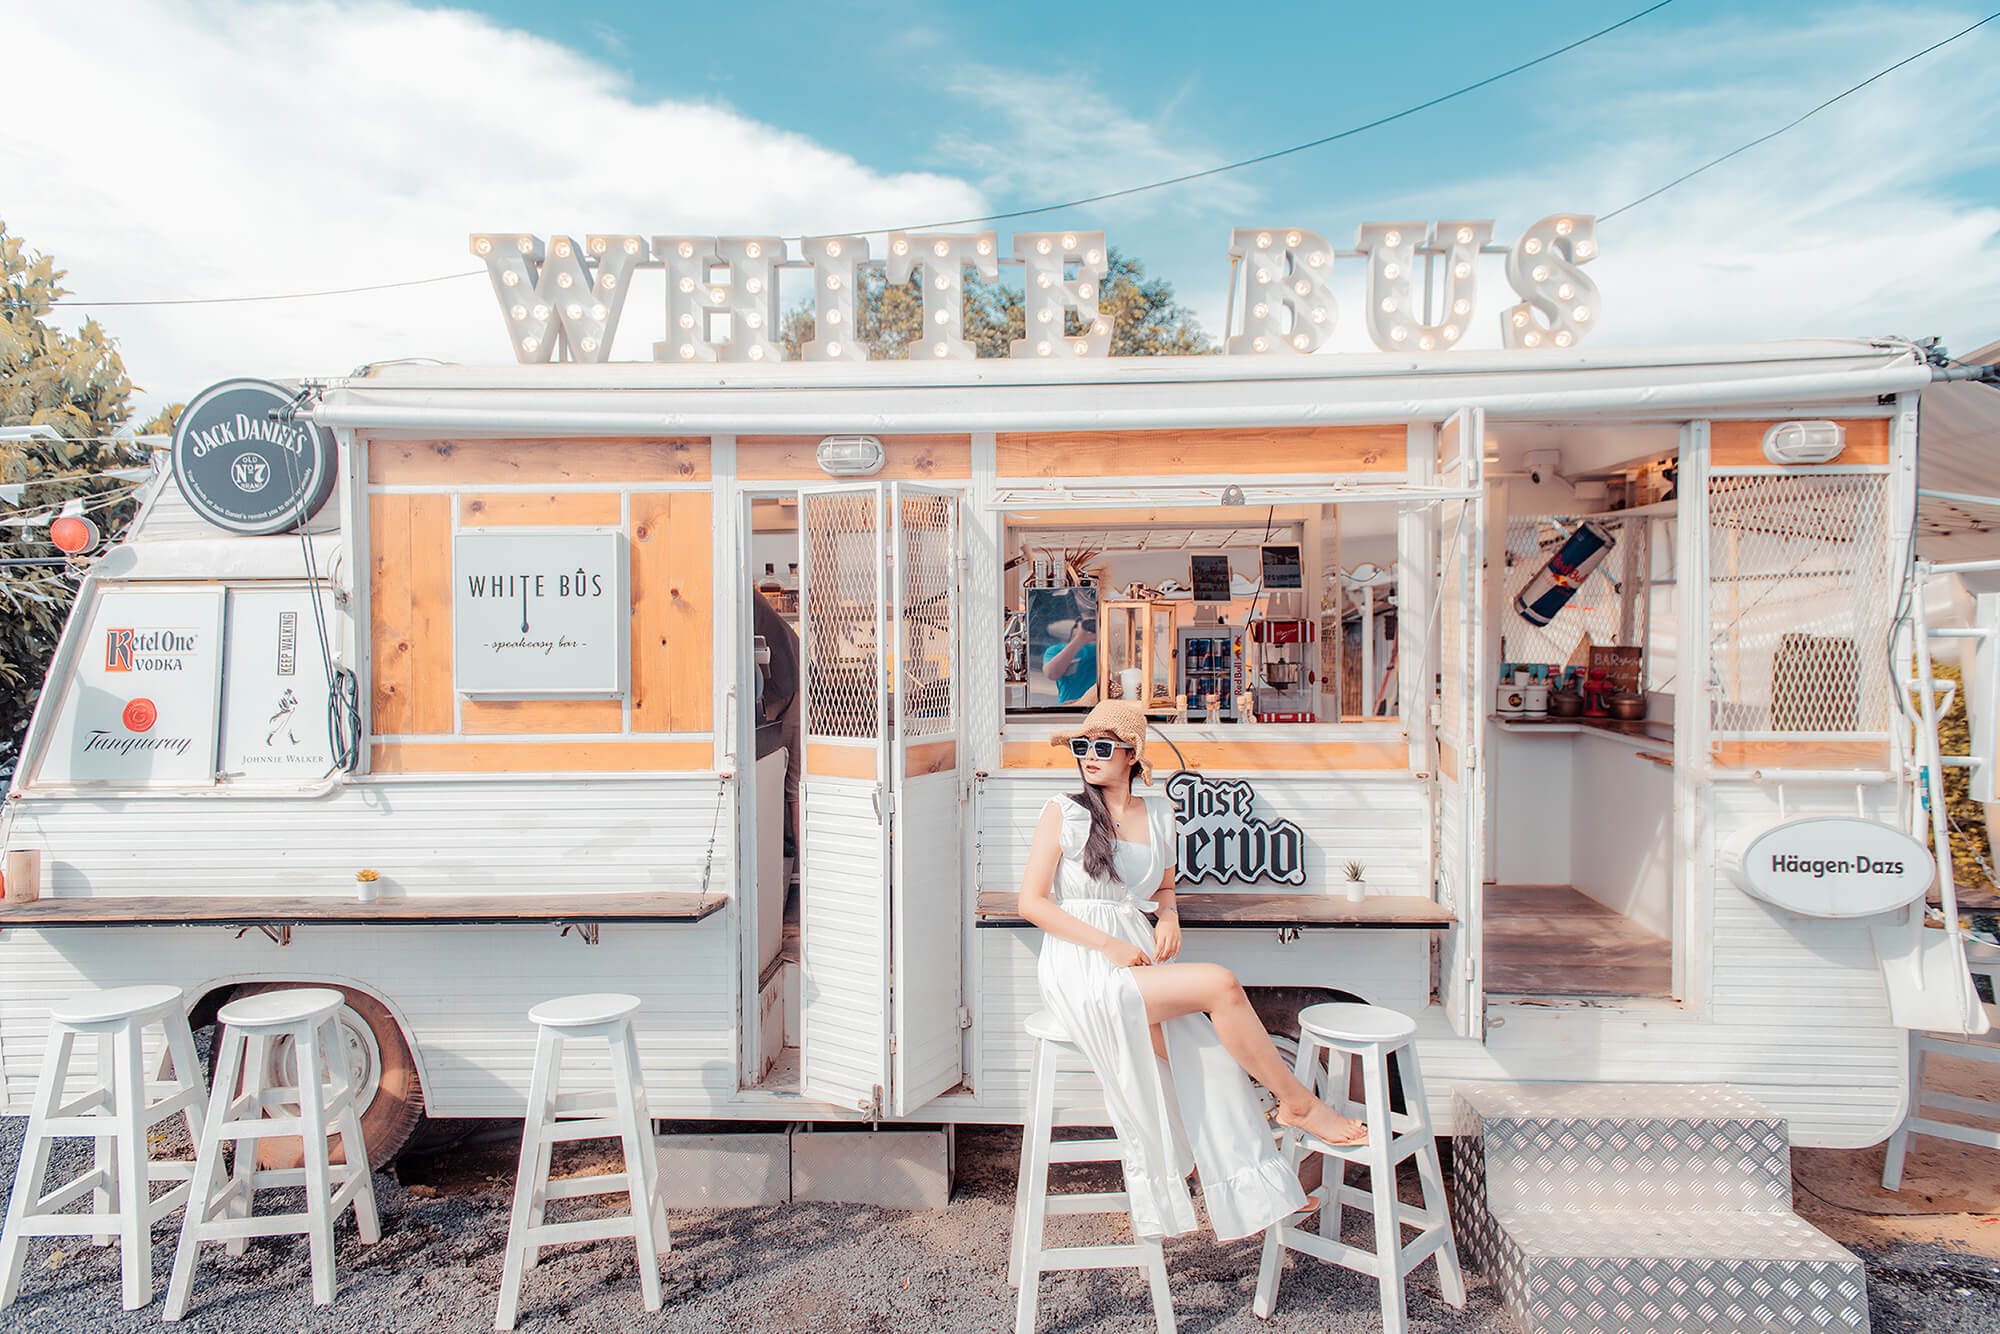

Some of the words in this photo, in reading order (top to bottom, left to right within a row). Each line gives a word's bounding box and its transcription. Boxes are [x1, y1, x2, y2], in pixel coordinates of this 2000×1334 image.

[469, 230, 1112, 364] WHITE
[1226, 214, 1601, 355] BUS
[190, 420, 236, 457] JACK
[242, 455, 258, 464] OLD
[281, 614, 294, 652] WALKING
[109, 631, 160, 668] Ketel
[161, 631, 195, 652] One
[491, 637, 553, 656] speakeasy
[558, 635, 579, 648] bar
[135, 658, 183, 671] VODKA
[280, 653, 293, 673] KEEP
[1233, 662, 1242, 681] Bull
[1233, 681, 1242, 696] Red
[84, 730, 192, 756] Tanqueray
[242, 755, 282, 765] JOHNNIE
[286, 755, 324, 764] WALKER
[1172, 778, 1249, 825] Jose
[1176, 826, 1298, 879] ervo
